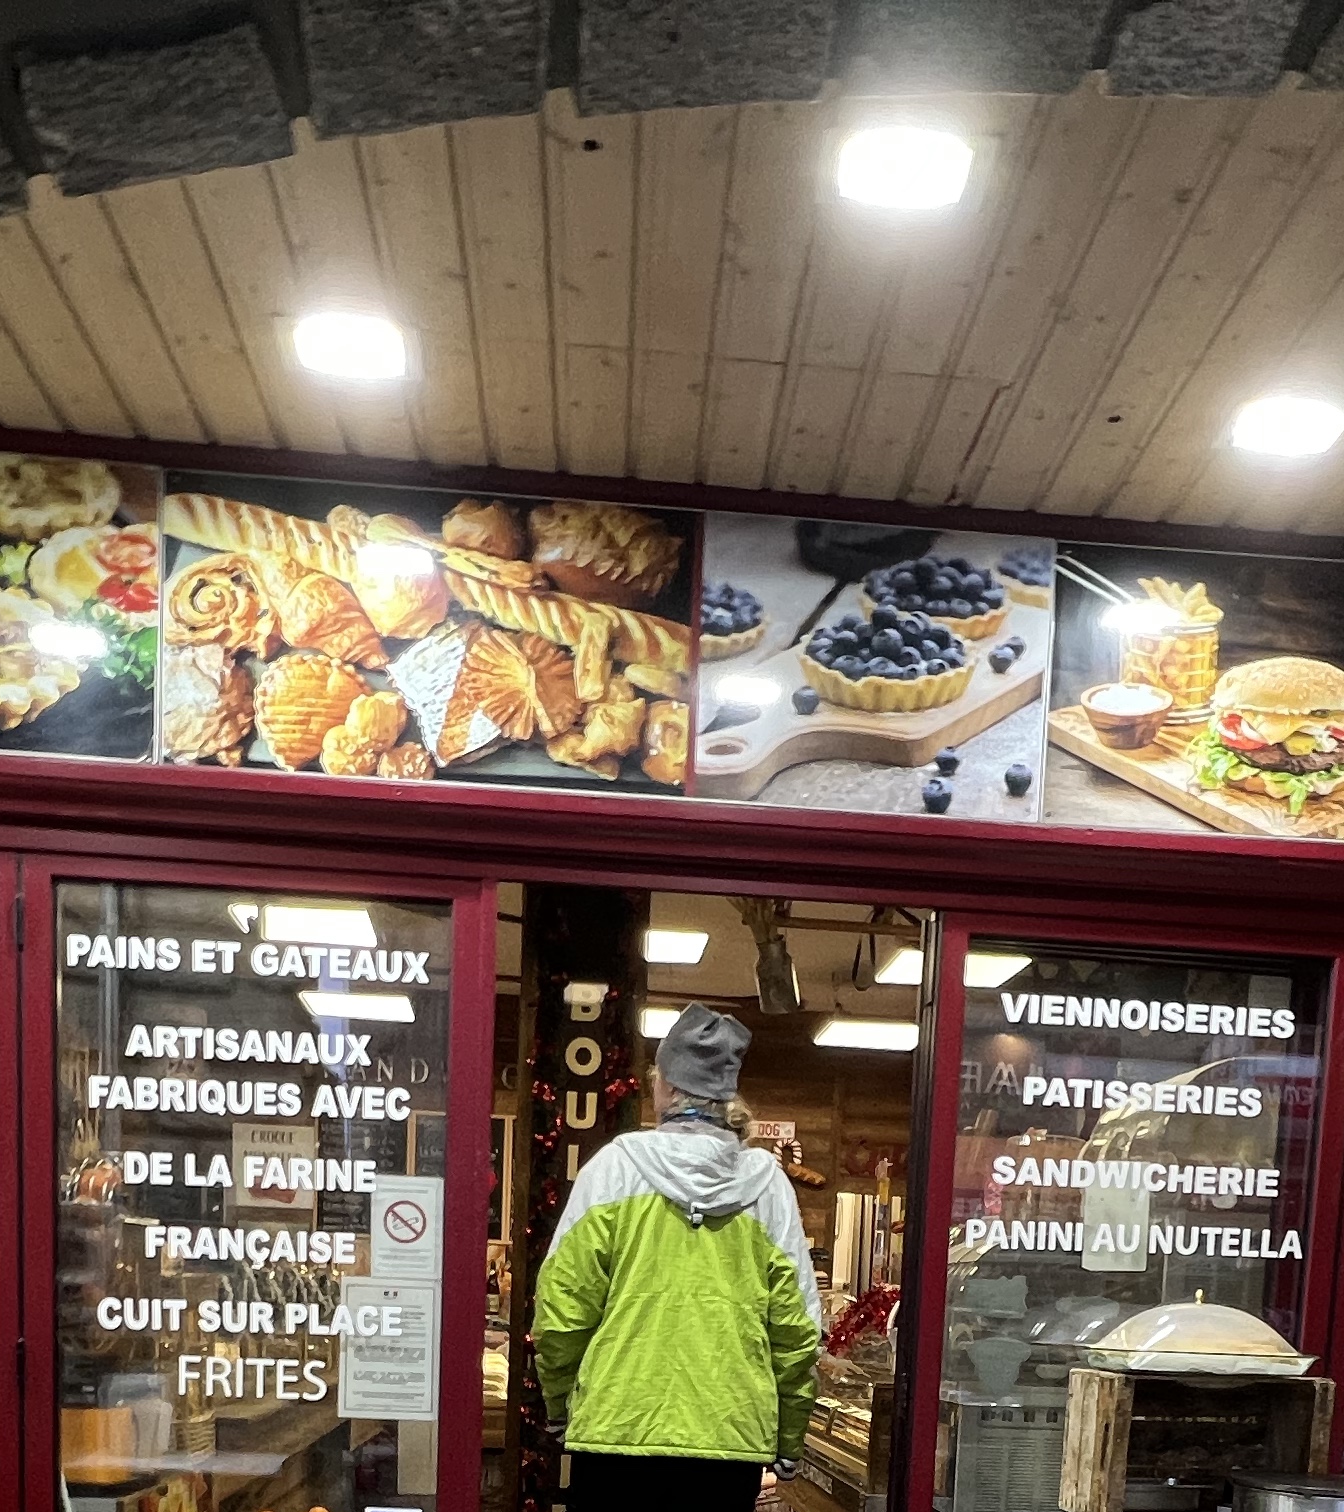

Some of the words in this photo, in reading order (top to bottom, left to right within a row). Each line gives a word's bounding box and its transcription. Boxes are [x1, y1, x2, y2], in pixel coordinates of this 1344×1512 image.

[66, 934, 181, 972] PAINS
[191, 939, 241, 974] ET
[250, 944, 430, 985] GATEAUX
[1001, 992, 1296, 1041] VIENNOISERIES
[125, 1024, 372, 1067] ARTISANAUX
[88, 1075, 302, 1117] FABRIQUES
[311, 1085, 412, 1121] AVEC
[1022, 1075, 1263, 1118] PATISSERIES
[123, 1151, 174, 1187] DE
[184, 1153, 233, 1188] LA
[243, 1156, 378, 1194] FARINE
[992, 1155, 1280, 1200] SANDWICHERIE
[144, 1225, 356, 1269] FRANÇAISE
[965, 1218, 1083, 1252] PANINI
[1090, 1223, 1140, 1254] AU
[1148, 1224, 1303, 1260] NUTELLA
[97, 1297, 186, 1333] CUIT
[197, 1299, 275, 1335] SUR
[285, 1301, 403, 1338] PLACE
[177, 1354, 327, 1402] FRITES
